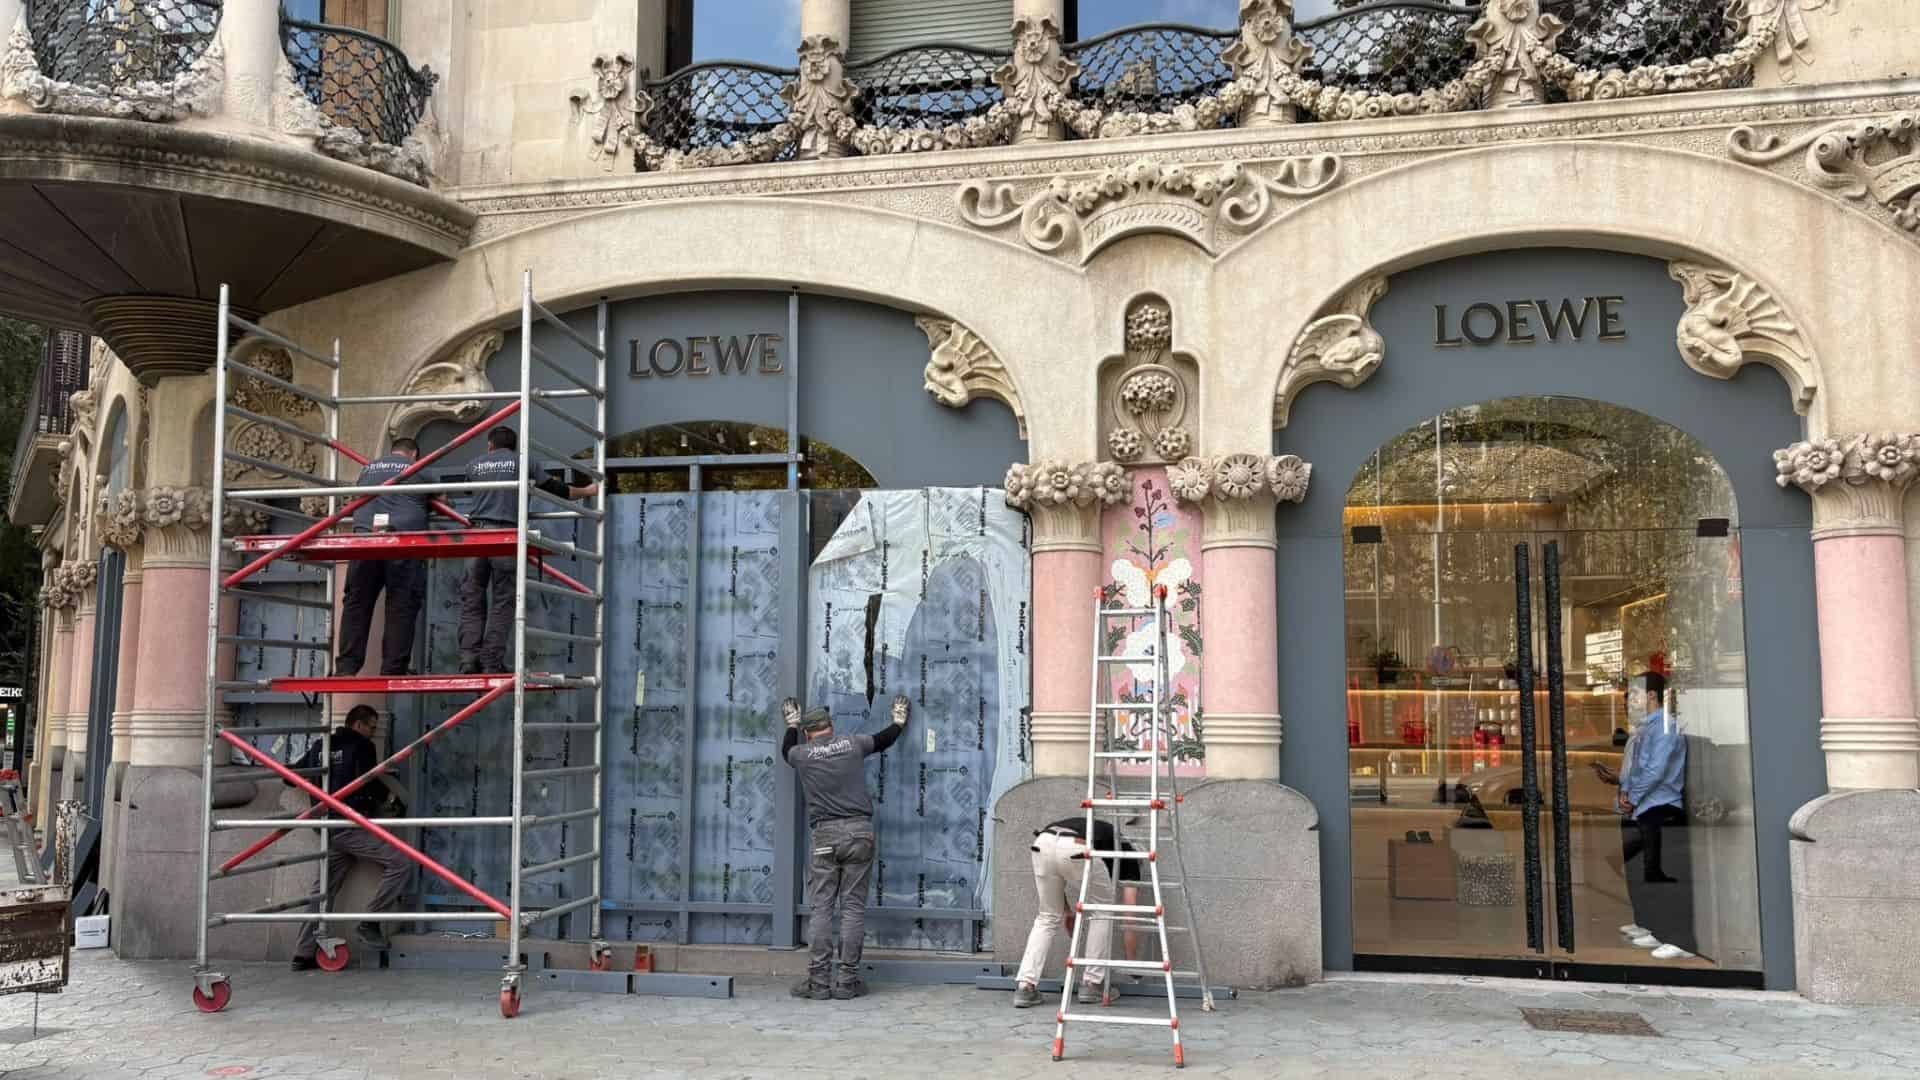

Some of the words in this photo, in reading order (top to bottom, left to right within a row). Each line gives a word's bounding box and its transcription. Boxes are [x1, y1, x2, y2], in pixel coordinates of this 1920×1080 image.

[1434, 295, 1626, 348] LOEWE
[628, 332, 783, 378] LOEWE
[821, 602, 833, 653] PoliComp
[1016, 601, 1027, 655] PoliComp
